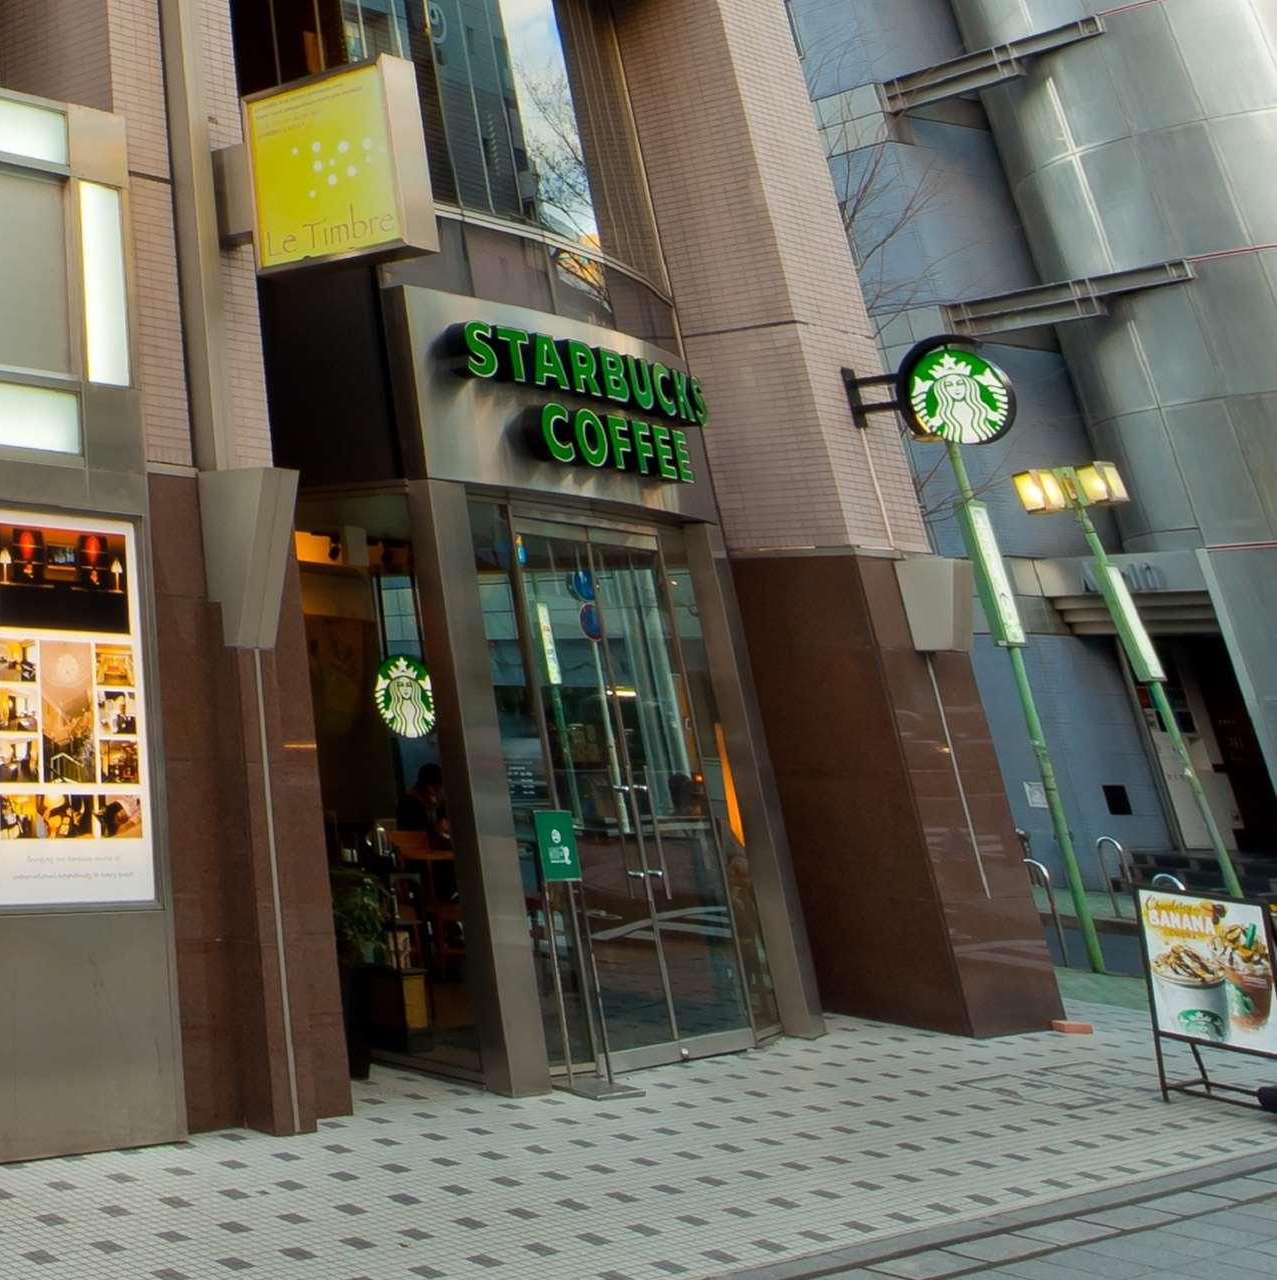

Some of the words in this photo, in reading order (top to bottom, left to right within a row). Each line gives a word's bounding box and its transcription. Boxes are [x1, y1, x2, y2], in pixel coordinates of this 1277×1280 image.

[266, 230, 298, 257] Le
[302, 203, 395, 249] Timbre
[463, 320, 708, 426] STARBUCKS
[541, 402, 696, 484] COFFEE
[1147, 908, 1216, 935] BANANA
